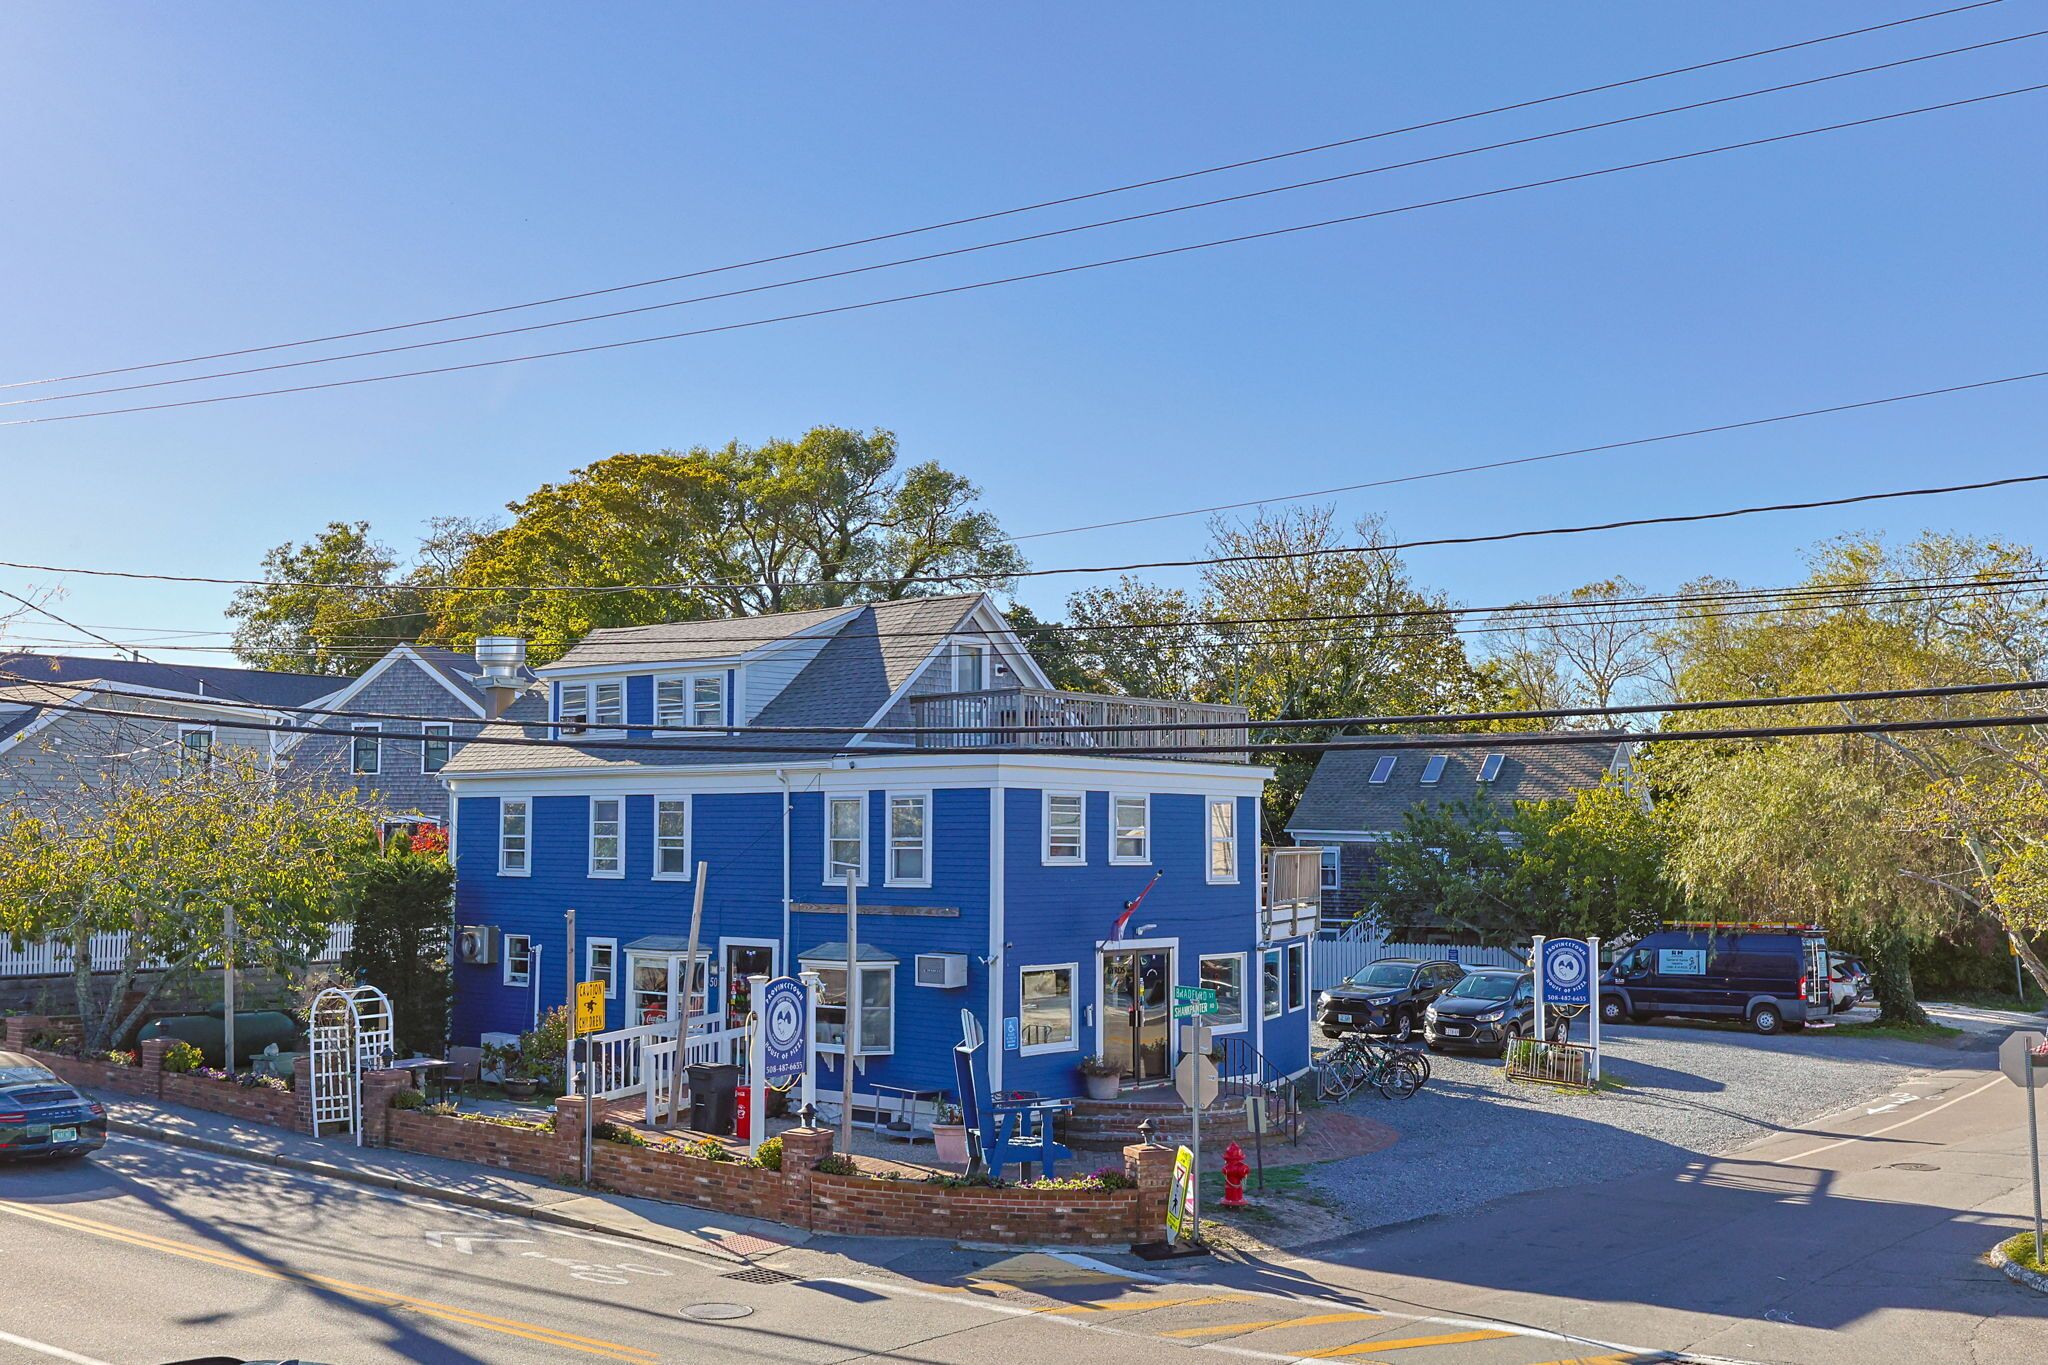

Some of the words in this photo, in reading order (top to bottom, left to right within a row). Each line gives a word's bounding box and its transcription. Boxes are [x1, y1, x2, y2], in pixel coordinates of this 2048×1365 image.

[1546, 942, 1586, 956] PROVINCETOWN
[710, 977, 718, 987] 50
[1545, 979, 1561, 992] HOUSE
[1572, 981, 1587, 992] PIZZA
[579, 983, 602, 997] CAUTION
[766, 982, 804, 1004] PROVINCETOWN
[579, 1015, 602, 1029] CHILDREN
[765, 1041, 780, 1059] HOUSE
[781, 1052, 789, 1060] OF
[790, 1038, 804, 1057] PIZZA
